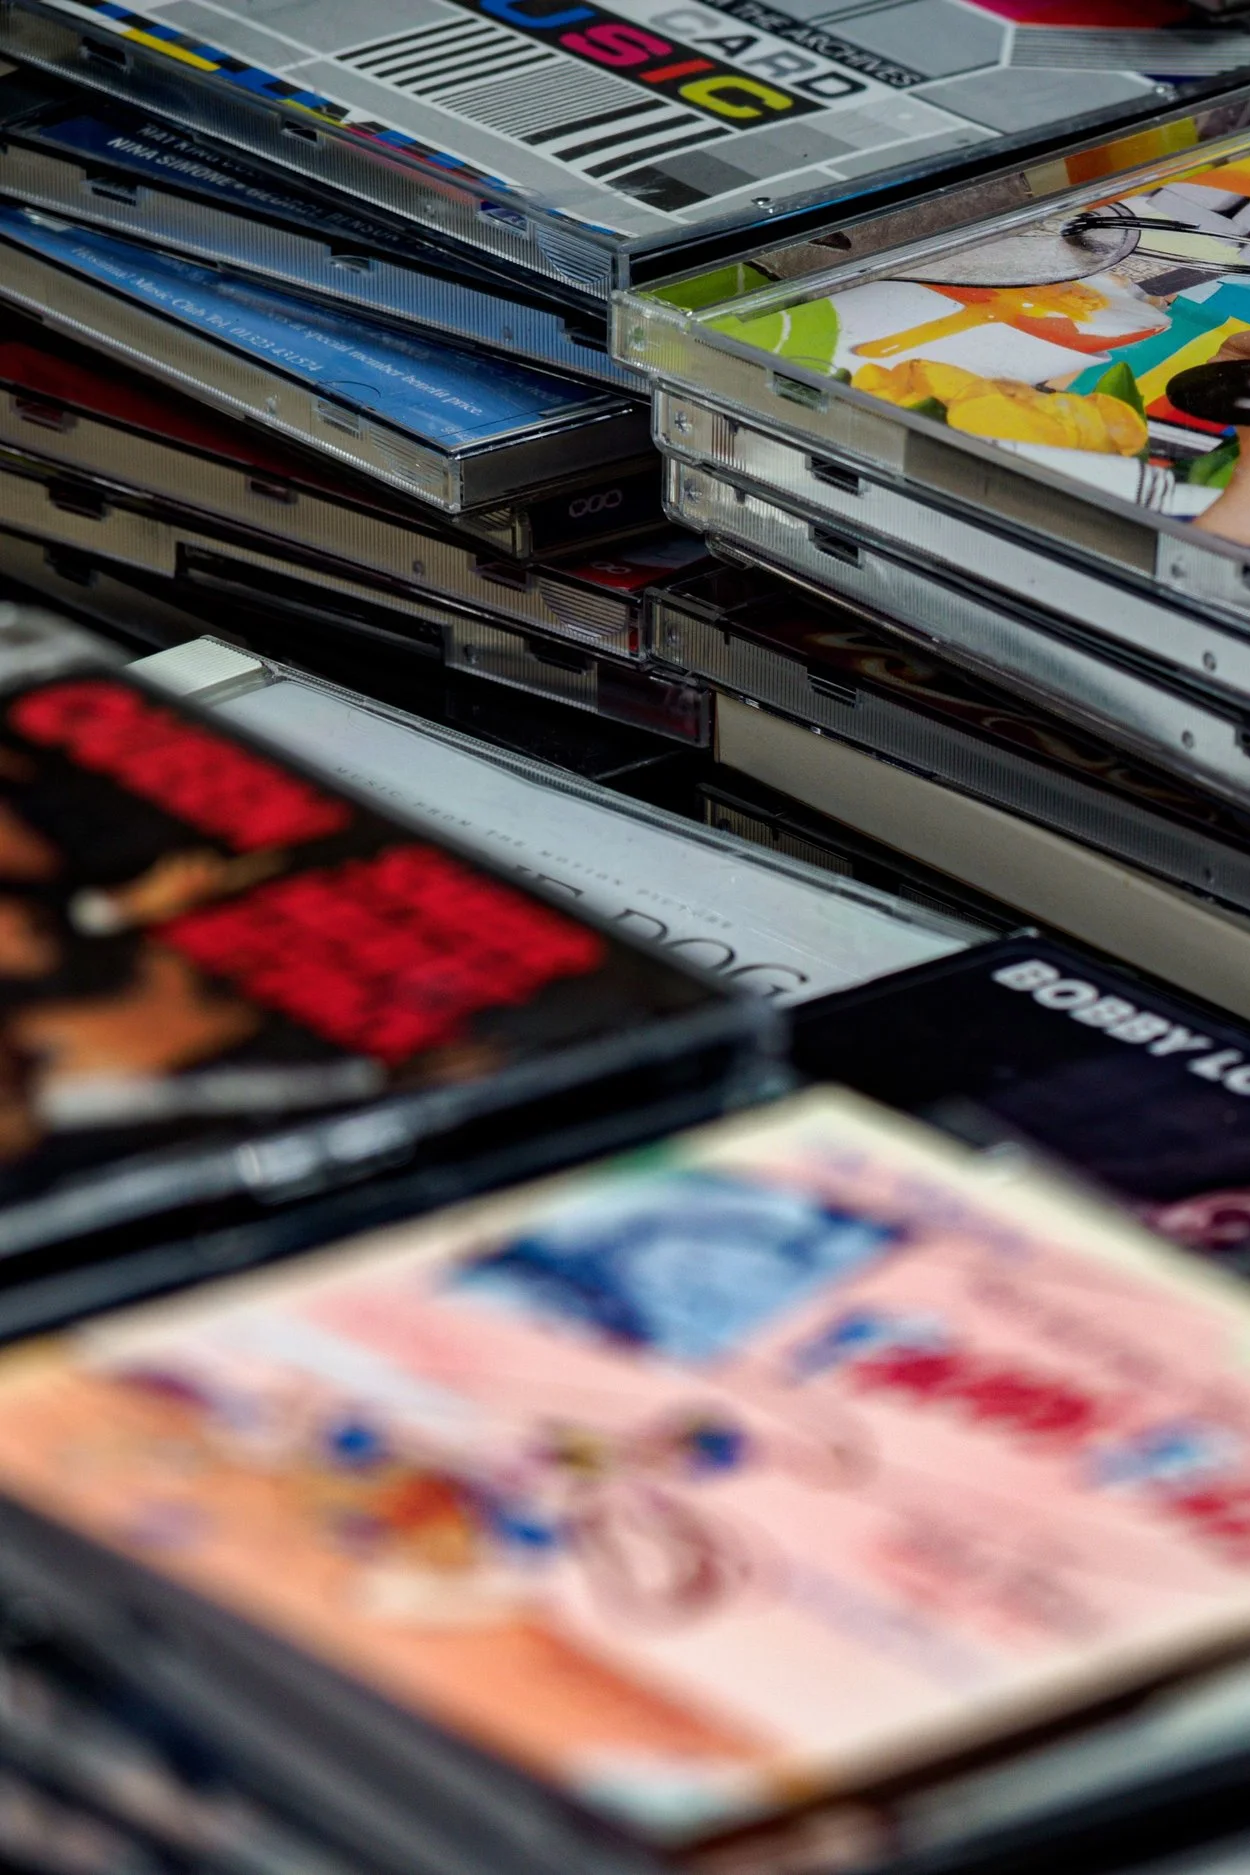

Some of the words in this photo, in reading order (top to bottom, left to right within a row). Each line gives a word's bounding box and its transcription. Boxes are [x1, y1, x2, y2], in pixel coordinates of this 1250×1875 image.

[648, 8, 869, 99] CARD
[780, 27, 922, 88] ARCHIVES
[106, 137, 159, 161] NINA
[155, 153, 233, 187] SIMONE
[991, 958, 1214, 1057] BOBBY
